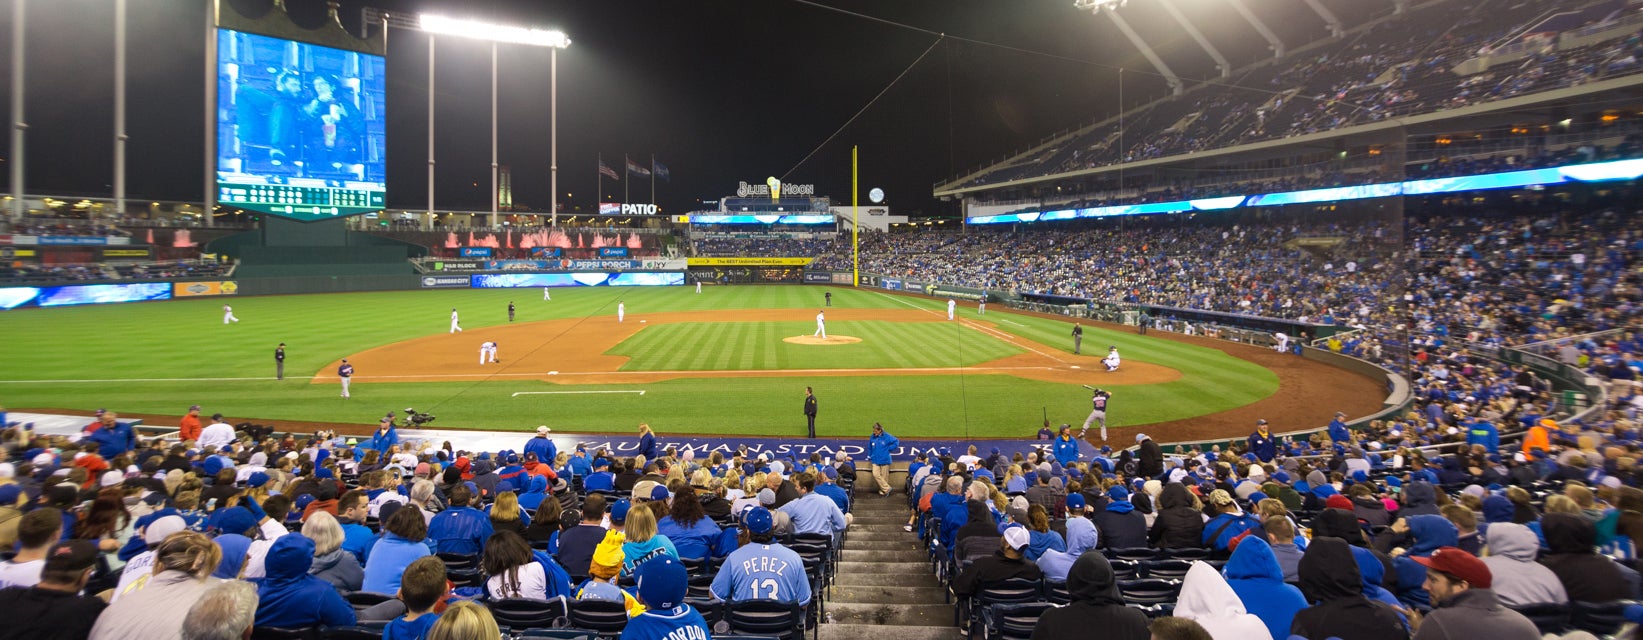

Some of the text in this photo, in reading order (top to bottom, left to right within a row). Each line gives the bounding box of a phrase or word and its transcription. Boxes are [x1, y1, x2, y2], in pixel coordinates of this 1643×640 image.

[737, 181, 814, 197] BLUE MOON
[621, 204, 657, 215] PATIO
[576, 261, 631, 269] PEPSI PORCH
[743, 556, 788, 577] PEREZ
[750, 577, 779, 601] 13
